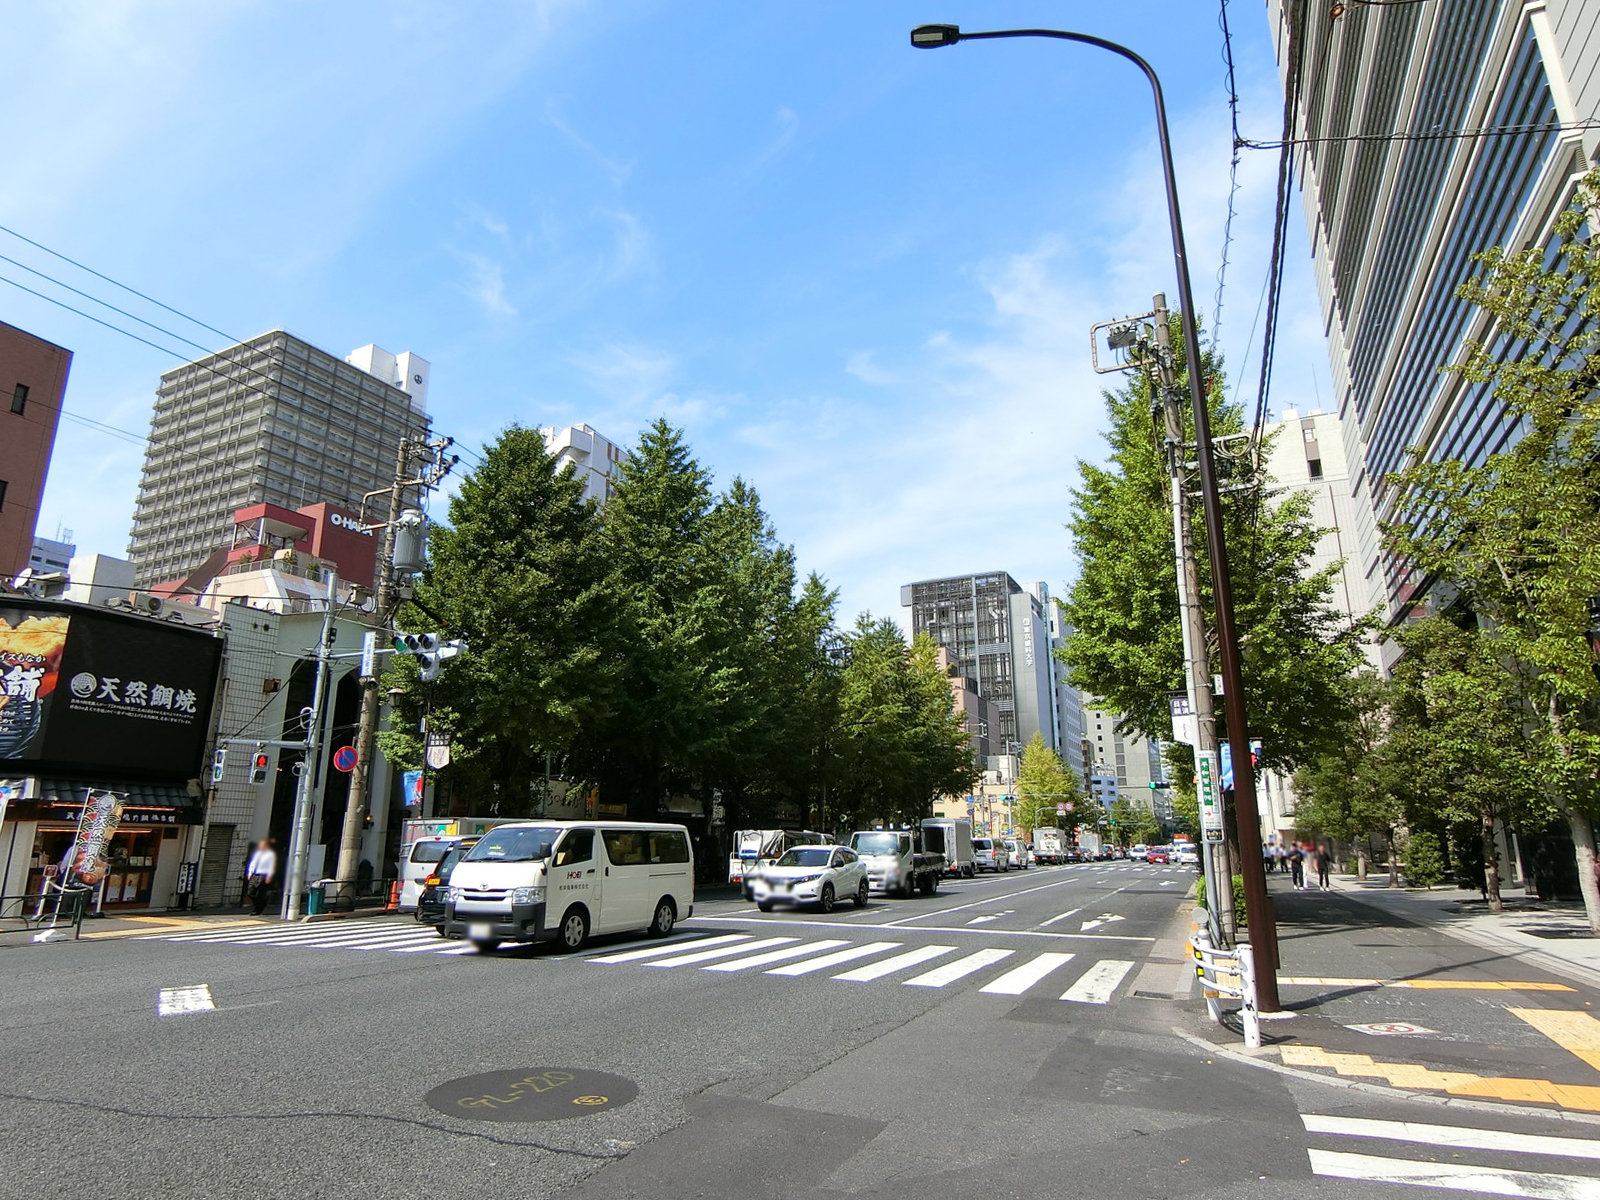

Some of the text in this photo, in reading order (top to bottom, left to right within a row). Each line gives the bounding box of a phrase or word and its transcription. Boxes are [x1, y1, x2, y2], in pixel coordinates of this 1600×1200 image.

[96, 676, 197, 713] 天然鯛焼
[456, 1071, 575, 1109] GL-220
